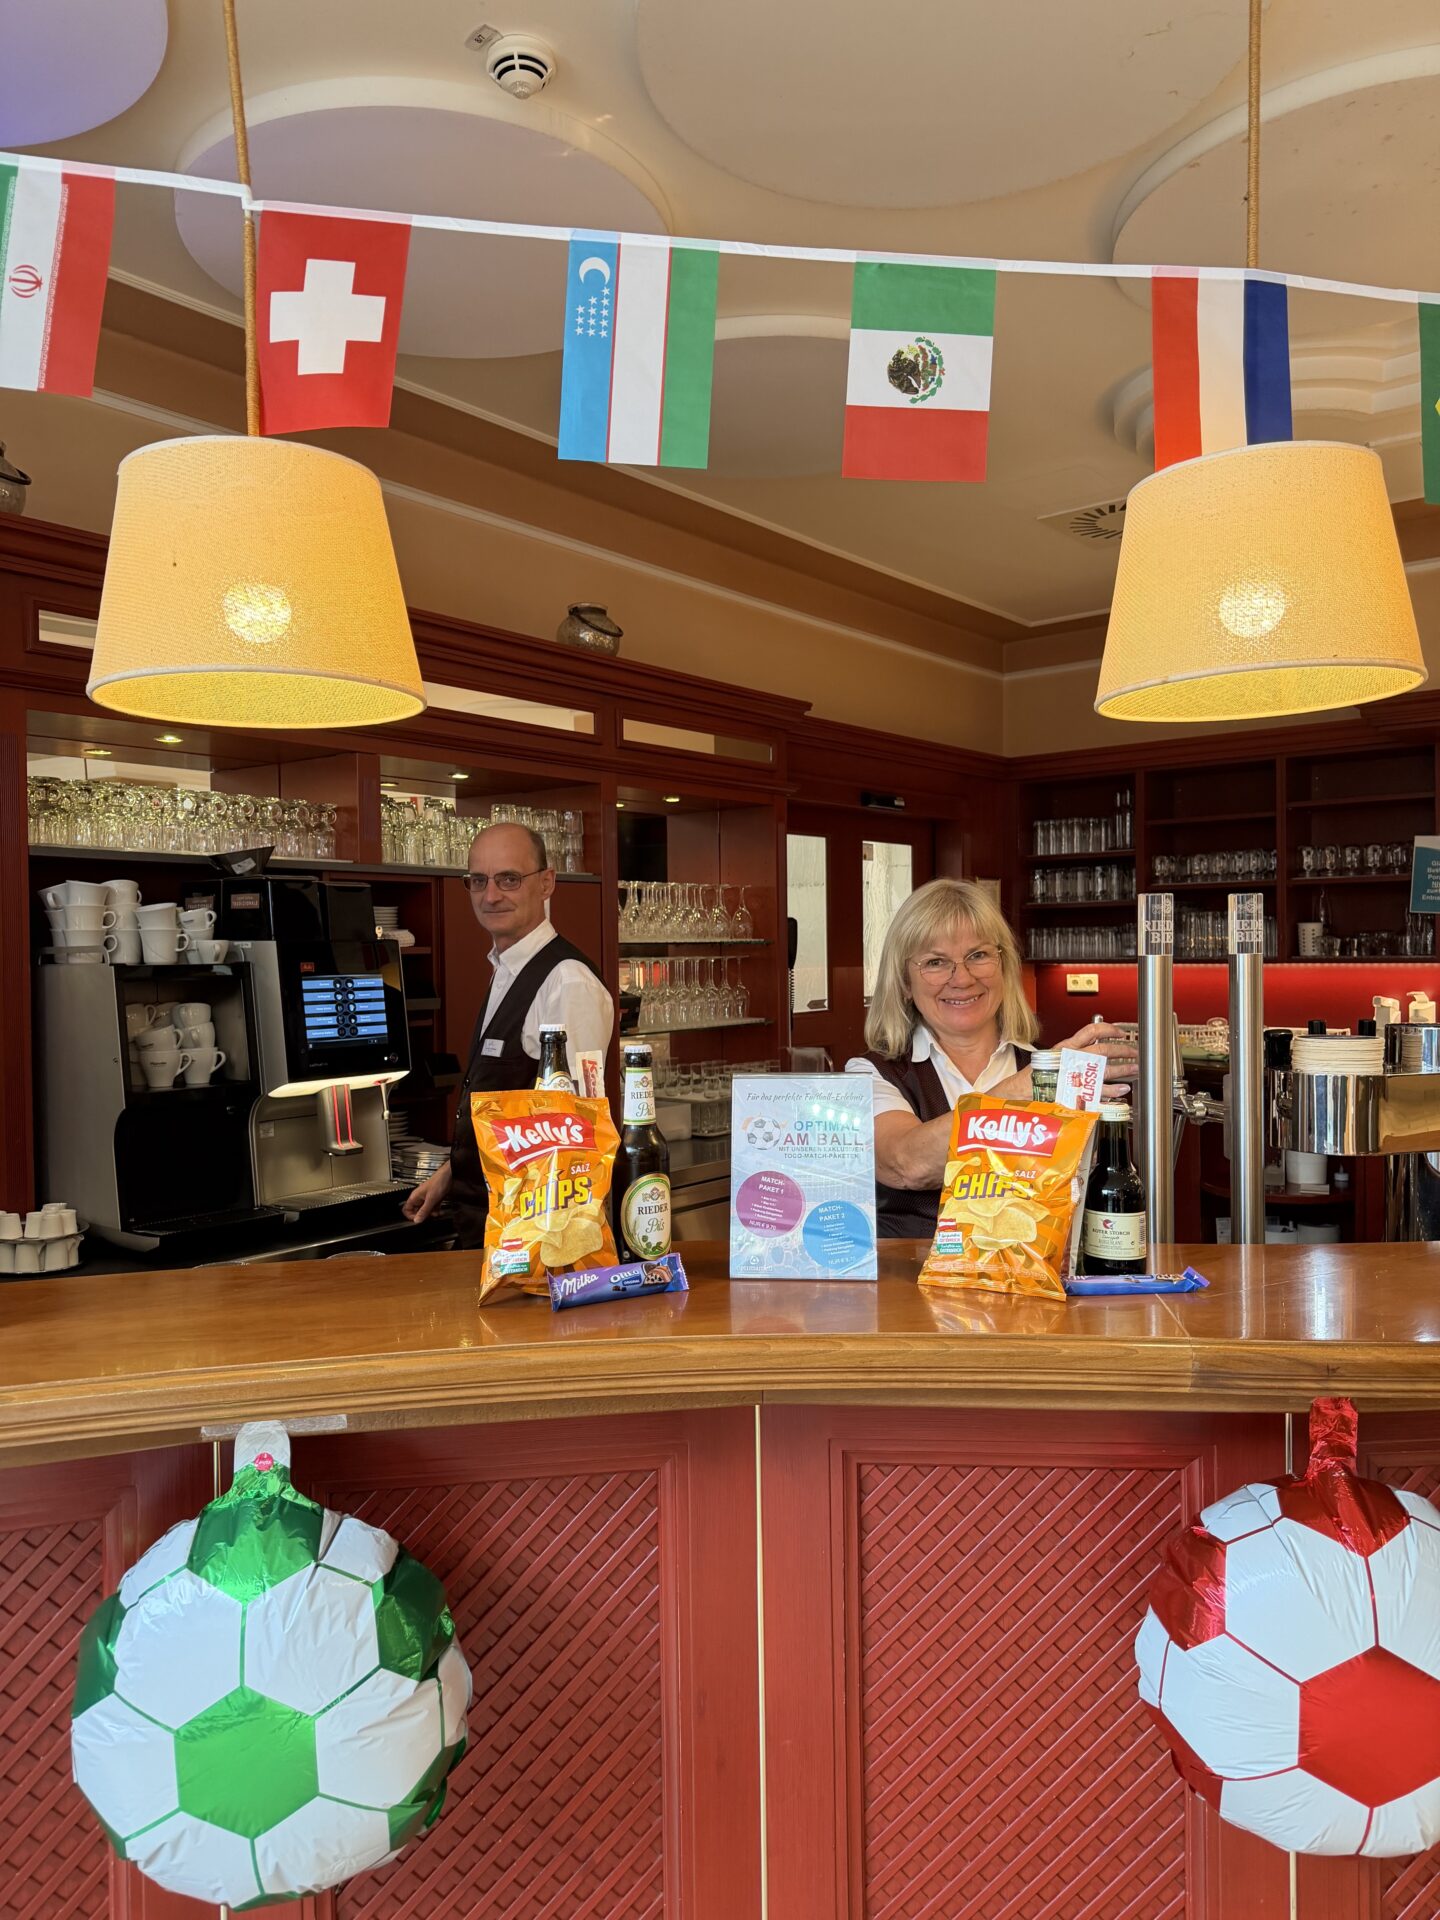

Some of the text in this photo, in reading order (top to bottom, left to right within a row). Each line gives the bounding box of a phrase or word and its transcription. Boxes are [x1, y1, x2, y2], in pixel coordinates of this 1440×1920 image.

[1082, 1062, 1099, 1102] CLASSIC
[794, 1120, 860, 1131] OPTIMAL
[967, 1114, 1048, 1147] Kelly's
[504, 1117, 584, 1152] Kelly's
[783, 1133, 863, 1145] AM BALL
[570, 1163, 590, 1175] SALZ
[1014, 1169, 1036, 1179] SALZ
[761, 1176, 785, 1186] MATCH-
[758, 1184, 780, 1193] PAKET
[519, 1176, 592, 1221] CHIPS
[637, 1203, 668, 1215] RIEDER
[819, 1213, 840, 1222] PAKET
[645, 1217, 665, 1233] Pils
[561, 1273, 599, 1296] Milka
